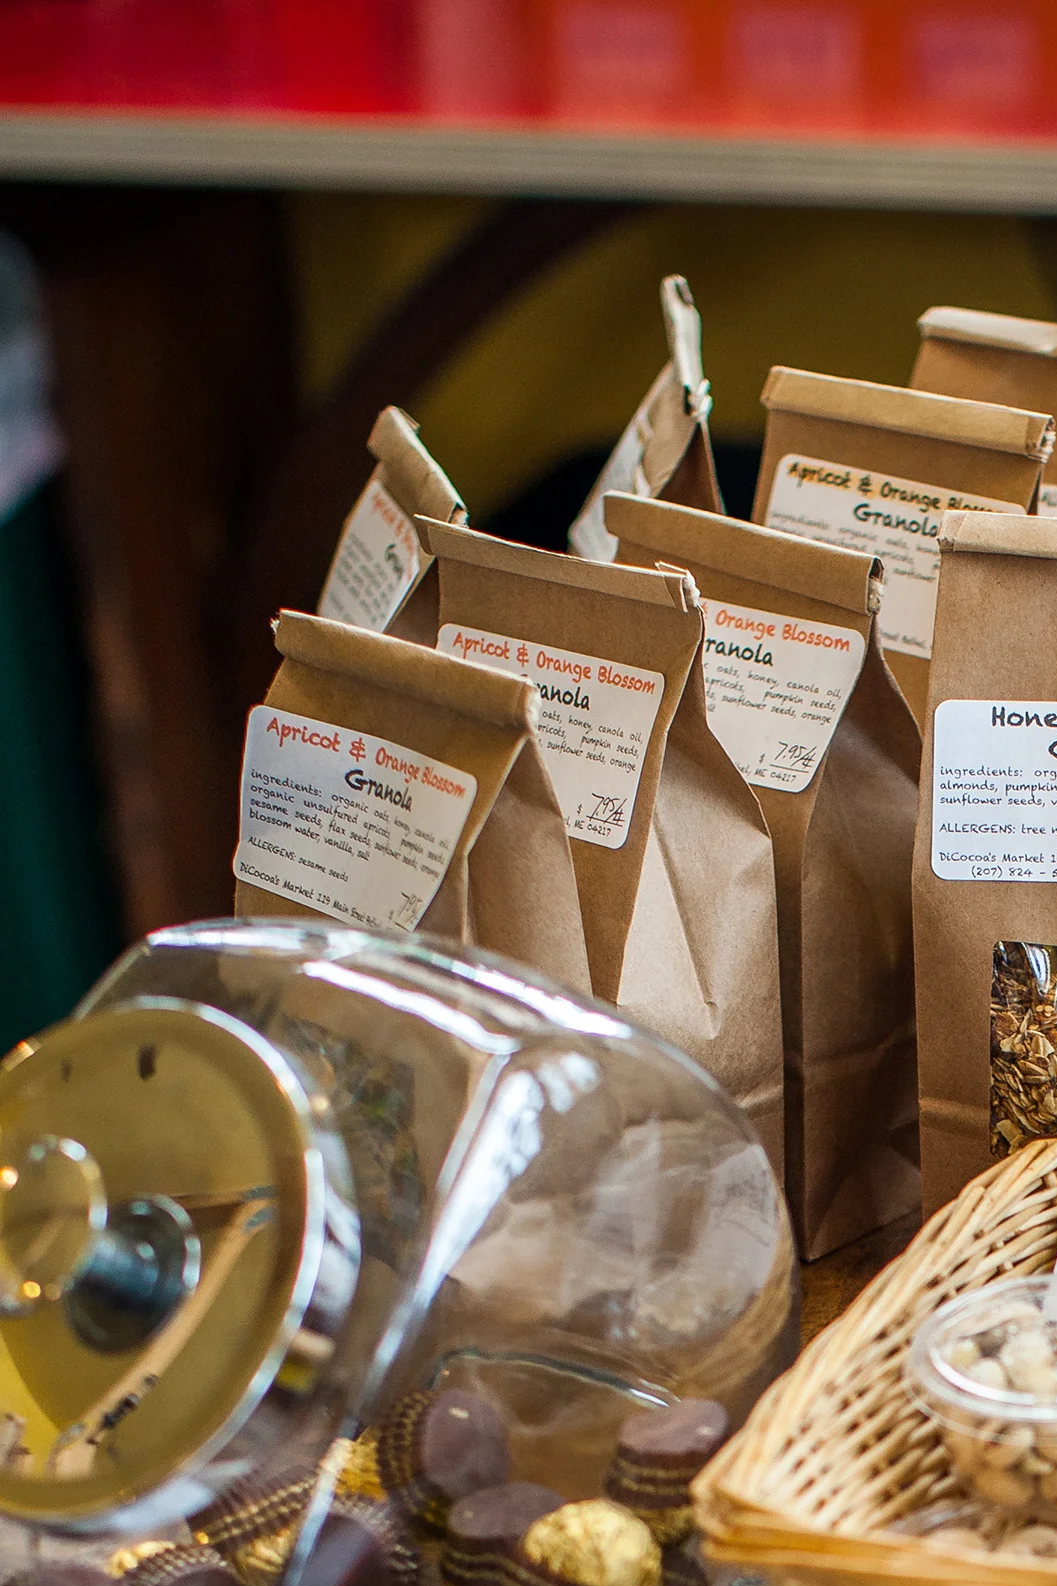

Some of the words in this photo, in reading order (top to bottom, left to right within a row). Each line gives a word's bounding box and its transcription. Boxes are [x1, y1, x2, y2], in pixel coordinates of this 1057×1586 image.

[787, 462, 852, 489] Apricot
[857, 475, 874, 495] &
[880, 482, 940, 513] Orange
[715, 609, 776, 641] Orange
[781, 624, 850, 652] Blossom
[453, 632, 510, 660] Apricot
[517, 643, 530, 667] &
[536, 651, 592, 684] Orange
[597, 666, 655, 695] Blossom
[704, 637, 773, 667] ranola
[534, 681, 590, 711] anola
[537, 724, 567, 740] pricots,
[542, 710, 562, 724] oats,
[568, 715, 593, 735] honey,
[598, 725, 624, 738] canola
[630, 731, 643, 744] oil,
[266, 717, 341, 752] Apricot
[349, 738, 366, 762] &
[375, 747, 420, 784] Orange
[422, 766, 466, 800] Blossom
[547, 739, 583, 757] sunflower
[586, 750, 607, 764] seeds,
[609, 757, 636, 774] orange
[940, 766, 1023, 779] ingredients:
[251, 769, 322, 797] ingredients:
[332, 793, 369, 814] organic
[344, 769, 412, 812] Granola
[940, 781, 997, 793] almonds,
[940, 794, 1002, 806] sunflower
[1008, 795, 1045, 806] seeds,
[250, 798, 289, 815] sesame
[295, 810, 323, 829] seeds,
[328, 819, 346, 836] flax
[251, 785, 295, 804] organic
[303, 800, 358, 825] unsulfured
[577, 804, 582, 816] $
[249, 808, 292, 830] blossom
[295, 824, 320, 843] water,
[324, 836, 354, 857] vanilla,
[574, 821, 585, 830] ME
[587, 823, 612, 837] 04217
[939, 824, 1016, 835] ALLERGENS:
[1021, 825, 1046, 835] tree
[248, 836, 297, 863] ALLERGENS:
[298, 856, 327, 875] sesame
[329, 869, 349, 883] seeds
[939, 851, 996, 863] DiCocoa's
[1002, 853, 1044, 864] Market
[971, 866, 1002, 878] (207)
[1009, 867, 1033, 877] 824
[240, 862, 280, 886] DiCocoa's
[283, 881, 315, 900] Market
[317, 893, 330, 906] 119
